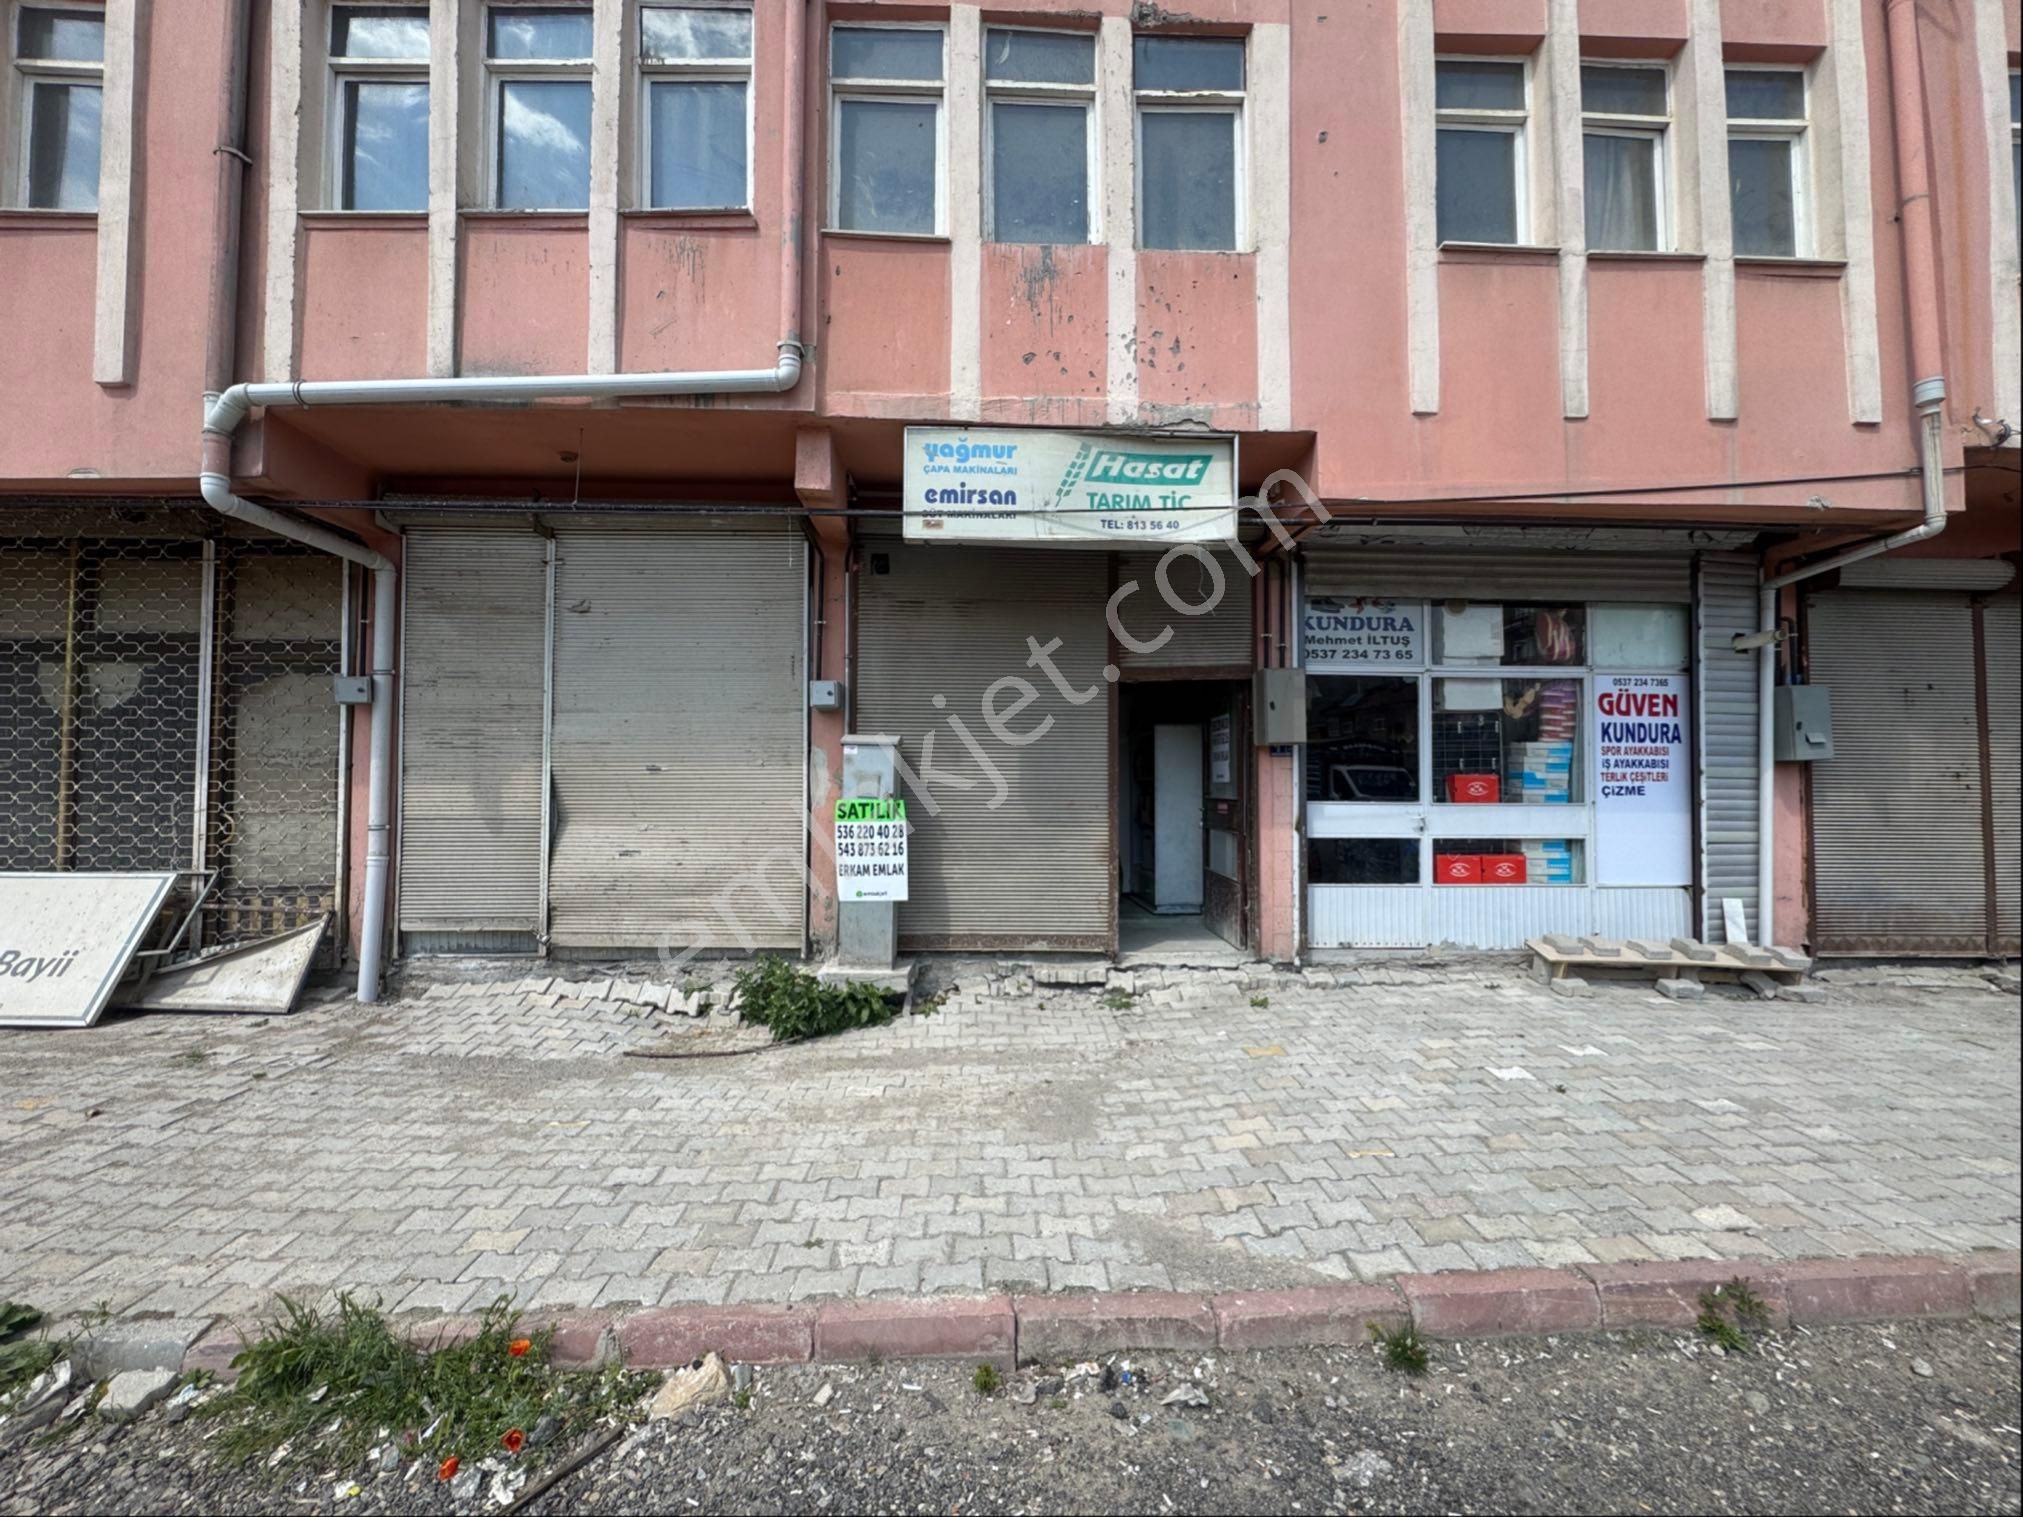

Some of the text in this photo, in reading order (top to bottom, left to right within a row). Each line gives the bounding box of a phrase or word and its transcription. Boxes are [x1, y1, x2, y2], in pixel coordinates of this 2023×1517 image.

[922, 437, 1017, 463] yağmur
[923, 465, 1017, 475] ÇAPA MAKİNALARI
[1092, 454, 1203, 479] Hasat
[924, 481, 1017, 505] emirsan
[1087, 493, 1151, 510] TARIM
[1101, 520, 1179, 530] TEL: 813 56 40
[1305, 633, 1410, 648] Mehmet İLTUŞ
[1342, 649, 1368, 659] 234
[1373, 649, 1391, 659] 73
[1395, 650, 1413, 660] 65
[1613, 678, 1669, 687] 0537 234 7365
[1598, 688, 1678, 717] GÜVEN
[1601, 722, 1681, 744] KUNDURA
[1601, 746, 1669, 756] SPOR AYAKKABISI
[1613, 759, 1669, 769] AYAKKABISI
[837, 802, 902, 819] SATILIK
[837, 824, 854, 839] 536
[857, 825, 875, 839] 220
[877, 825, 890, 839] 40
[838, 841, 904, 857] 543 873 62 16
[839, 863, 904, 876] ERKAM EMLAK
